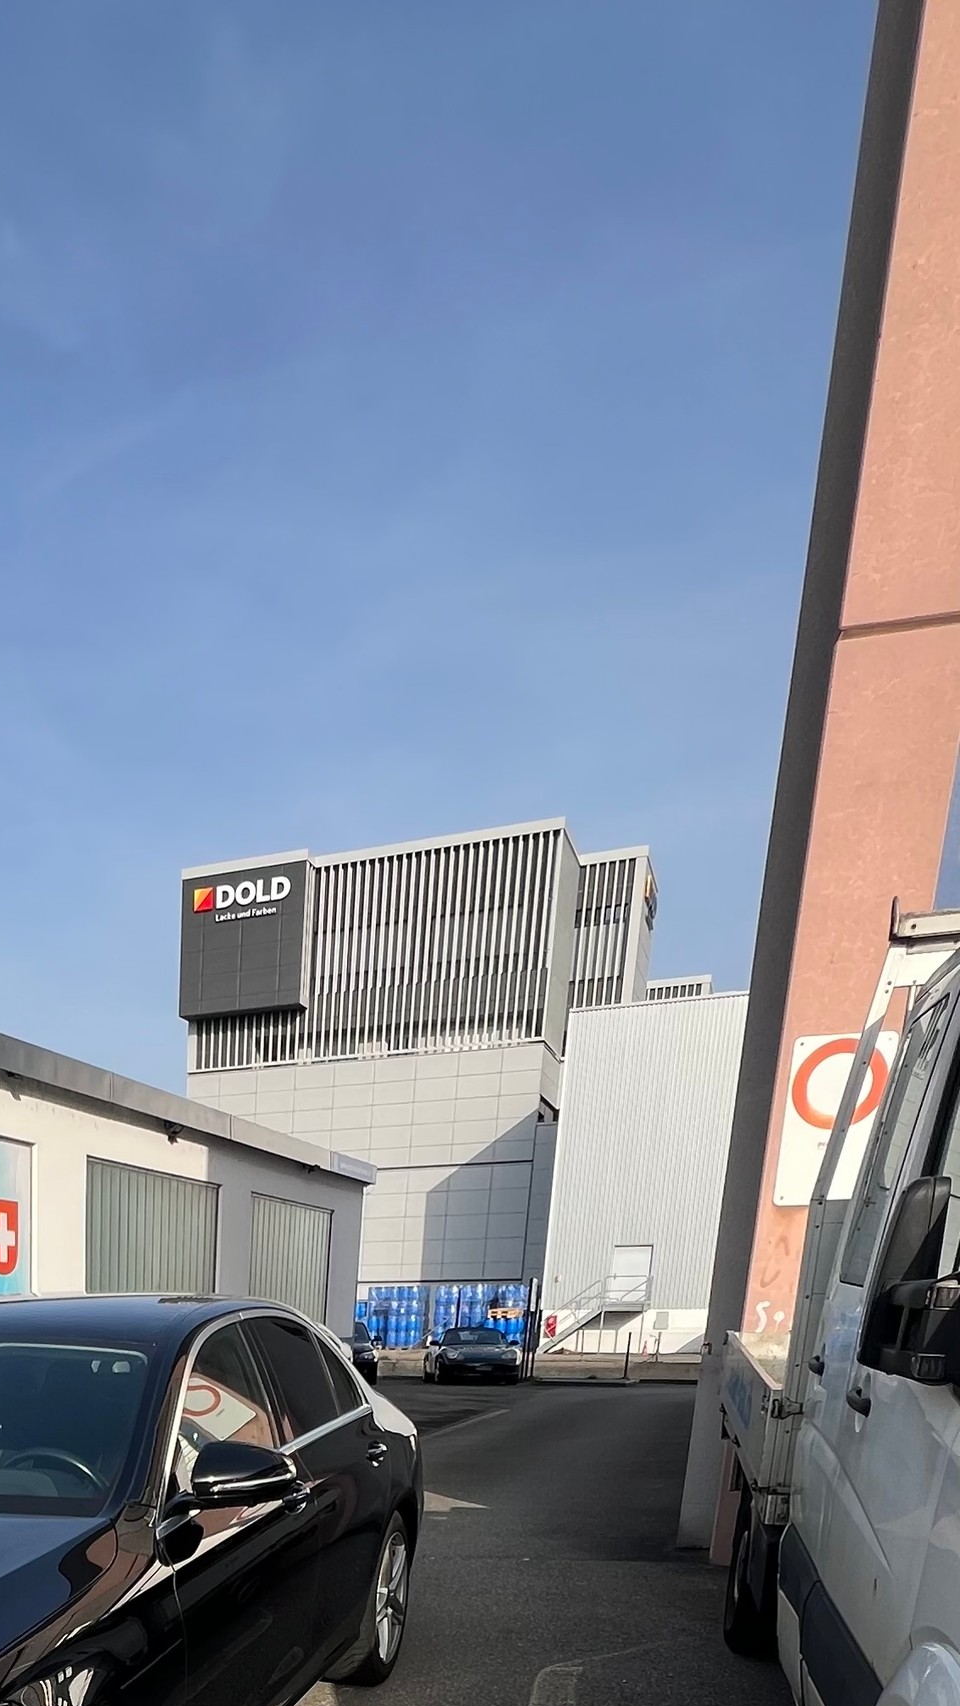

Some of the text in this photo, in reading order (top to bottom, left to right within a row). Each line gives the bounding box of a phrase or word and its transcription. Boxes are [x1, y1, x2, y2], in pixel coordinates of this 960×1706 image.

[215, 875, 291, 910] DOLD
[215, 906, 277, 922] Lacke und Farben
